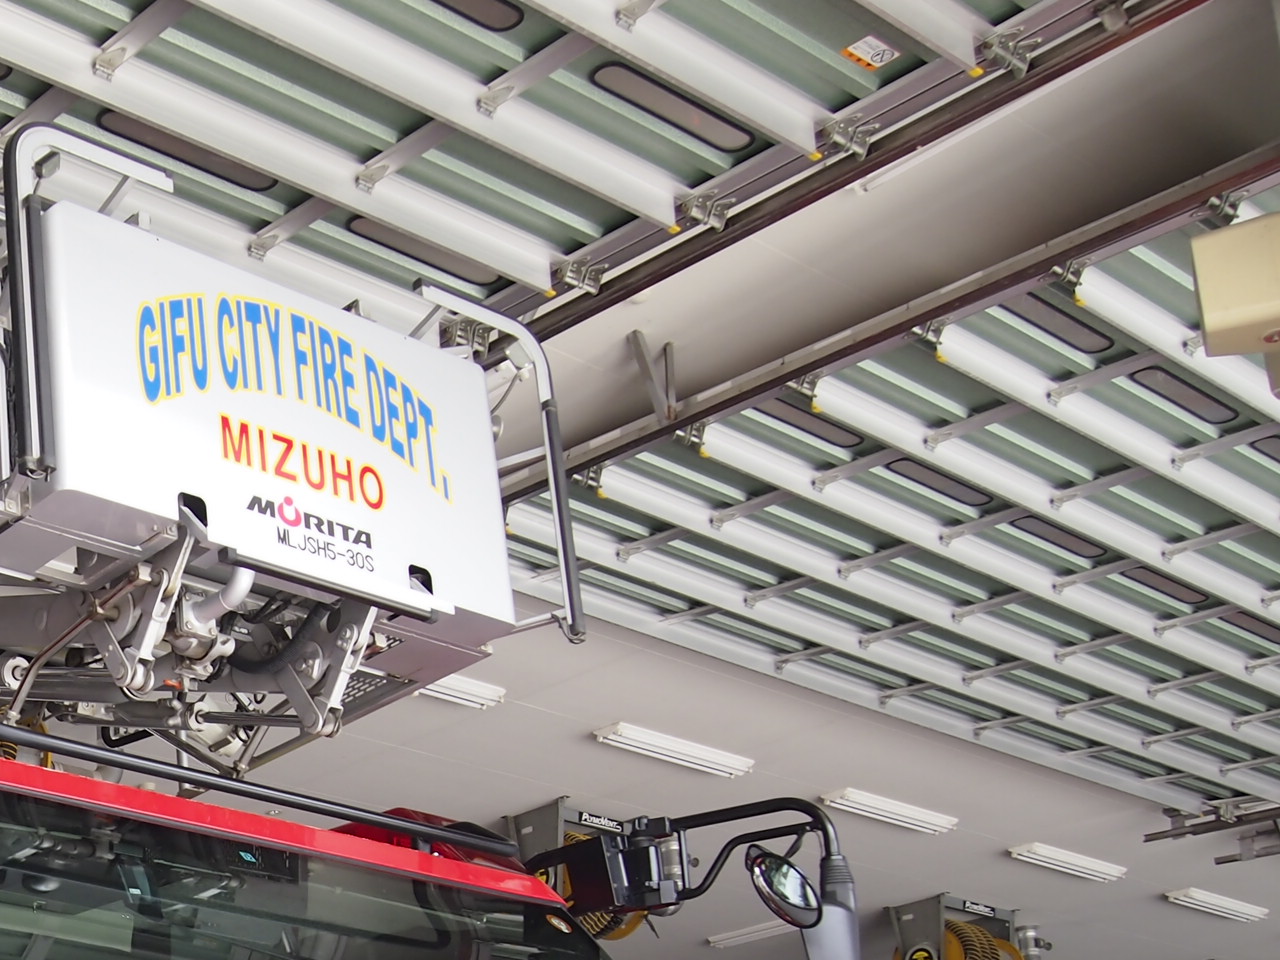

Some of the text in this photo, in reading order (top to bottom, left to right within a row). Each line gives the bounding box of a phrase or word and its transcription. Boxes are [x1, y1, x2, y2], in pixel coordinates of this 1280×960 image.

[137, 294, 451, 502] GIFU CITY FIRE DEPT.
[220, 413, 385, 511] MIZUHO
[247, 496, 373, 549] MORITA
[277, 526, 375, 573] MLJSH5-30S
